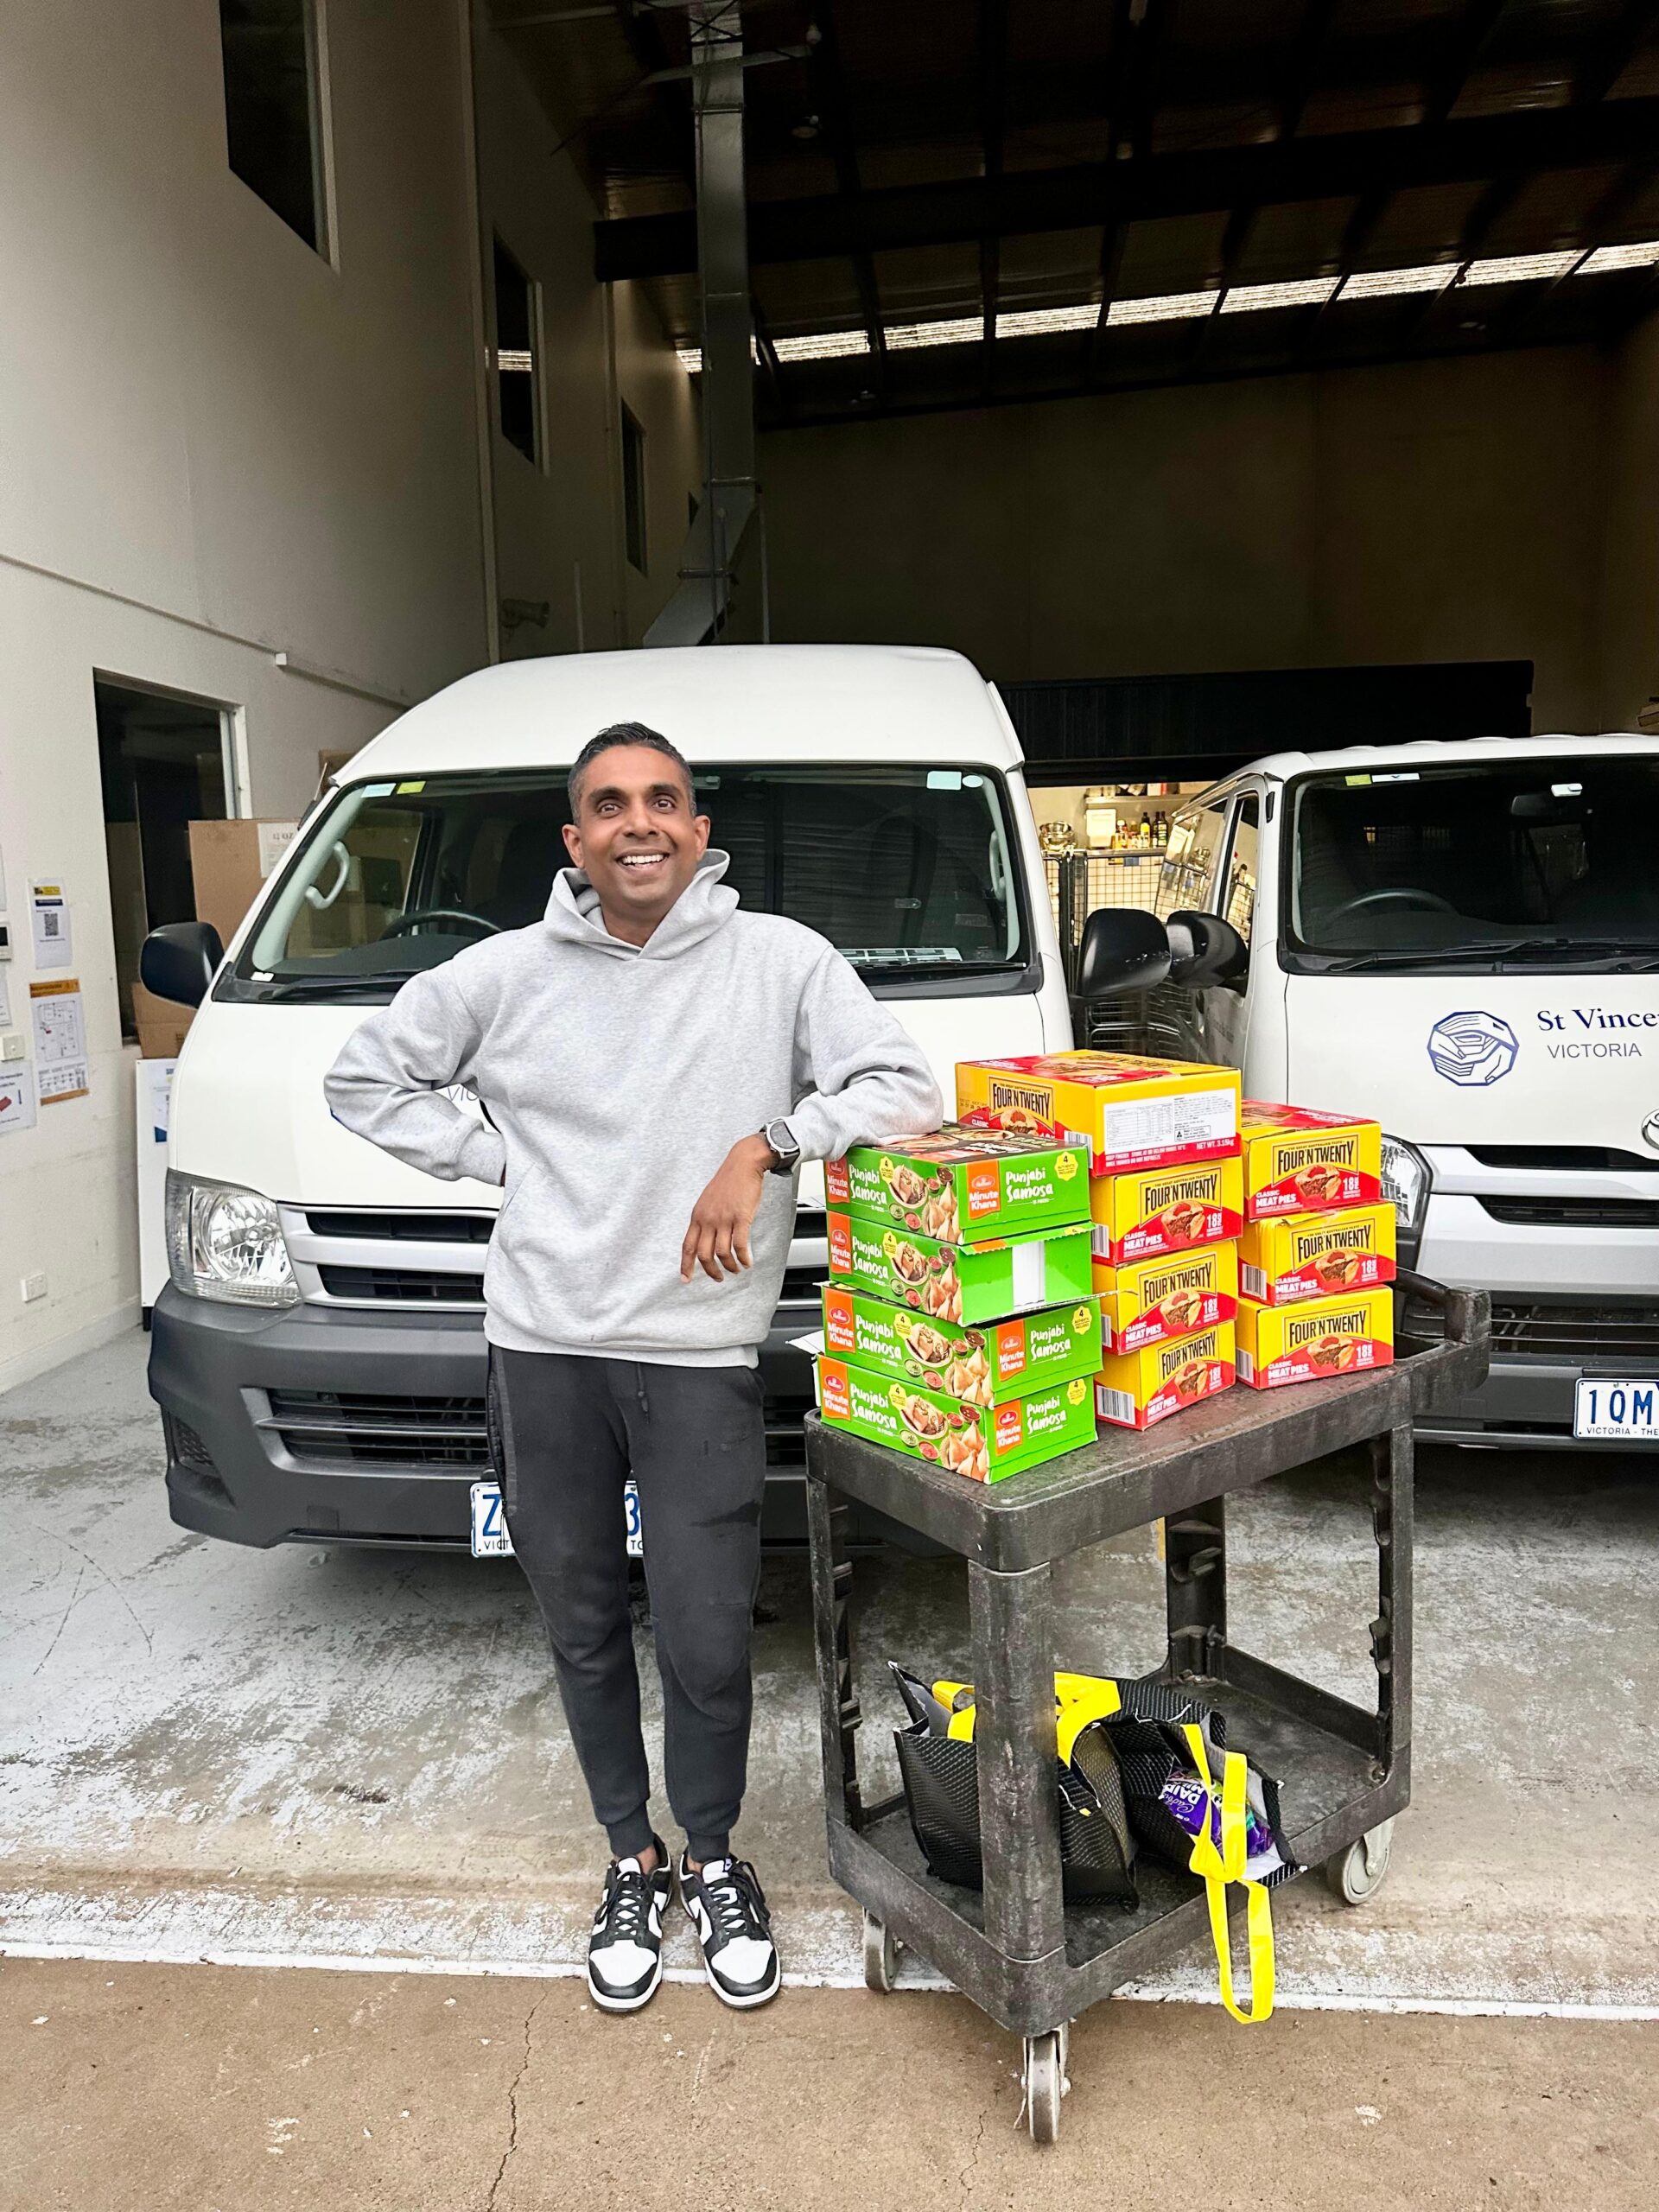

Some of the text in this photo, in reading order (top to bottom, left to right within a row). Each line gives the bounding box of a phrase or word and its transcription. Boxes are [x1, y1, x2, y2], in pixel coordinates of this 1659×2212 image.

[1537, 1007, 1659, 1031] St Vince
[1548, 1042, 1642, 1058] VICTORIA
[1020, 1091, 1050, 1120] TWENTY
[1314, 1141, 1354, 1165] TWENTY
[828, 1175, 848, 1186] Minute
[849, 1164, 880, 1185] Punjabi
[1006, 1168, 1046, 1185] Punjabi
[829, 1184, 848, 1198] Khana
[850, 1180, 887, 1205] Samosa
[1006, 1184, 1053, 1203] Samosa
[1179, 1174, 1217, 1200] TWENTY
[1343, 1178, 1354, 1192] 18
[969, 1191, 999, 1202] Minute
[971, 1199, 997, 1211] Khana
[1255, 1193, 1296, 1208] MEAT PIES
[1207, 1214, 1217, 1228] 18
[1124, 1235, 1162, 1250] MEAT PIES
[1332, 1224, 1371, 1249] TWENTY
[831, 1244, 851, 1257] Minute
[852, 1236, 883, 1259] Punjabi
[832, 1254, 850, 1268] Khana
[853, 1252, 888, 1279] Samosa
[1361, 1261, 1372, 1274] 18
[1177, 1262, 1212, 1288] TWENTY
[1275, 1281, 1300, 1294] MEAT
[1300, 1279, 1318, 1289] PIES
[1203, 1300, 1213, 1314] 18
[828, 1322, 854, 1337] Minute
[855, 1314, 894, 1338] Punjabi
[1327, 1310, 1366, 1334] TWENTY
[830, 1333, 853, 1347] Khana
[1030, 1324, 1065, 1344] Punjabi
[1126, 1329, 1146, 1343] MEAT
[1146, 1325, 1162, 1337] PIES
[856, 1330, 902, 1360] Samosa
[1031, 1338, 1071, 1361] Samosa
[1188, 1332, 1216, 1359] TWENTY
[1357, 1345, 1368, 1358] 18
[999, 1351, 1025, 1363] Minute
[1001, 1361, 1023, 1372] Khana
[1268, 1367, 1290, 1380] MEAT
[1291, 1363, 1309, 1376] PIES
[823, 1389, 849, 1406] Minute
[850, 1383, 888, 1408] Punjabi
[825, 1399, 849, 1415] Khana
[1027, 1396, 1060, 1416] Punjabi
[1589, 1389, 1653, 1425] 1QM
[852, 1400, 897, 1430] Samosa
[1027, 1410, 1066, 1434] Samosa
[996, 1425, 1020, 1438] Minute
[1641, 1427, 1659, 1436] THE
[998, 1435, 1020, 1447] Khana
